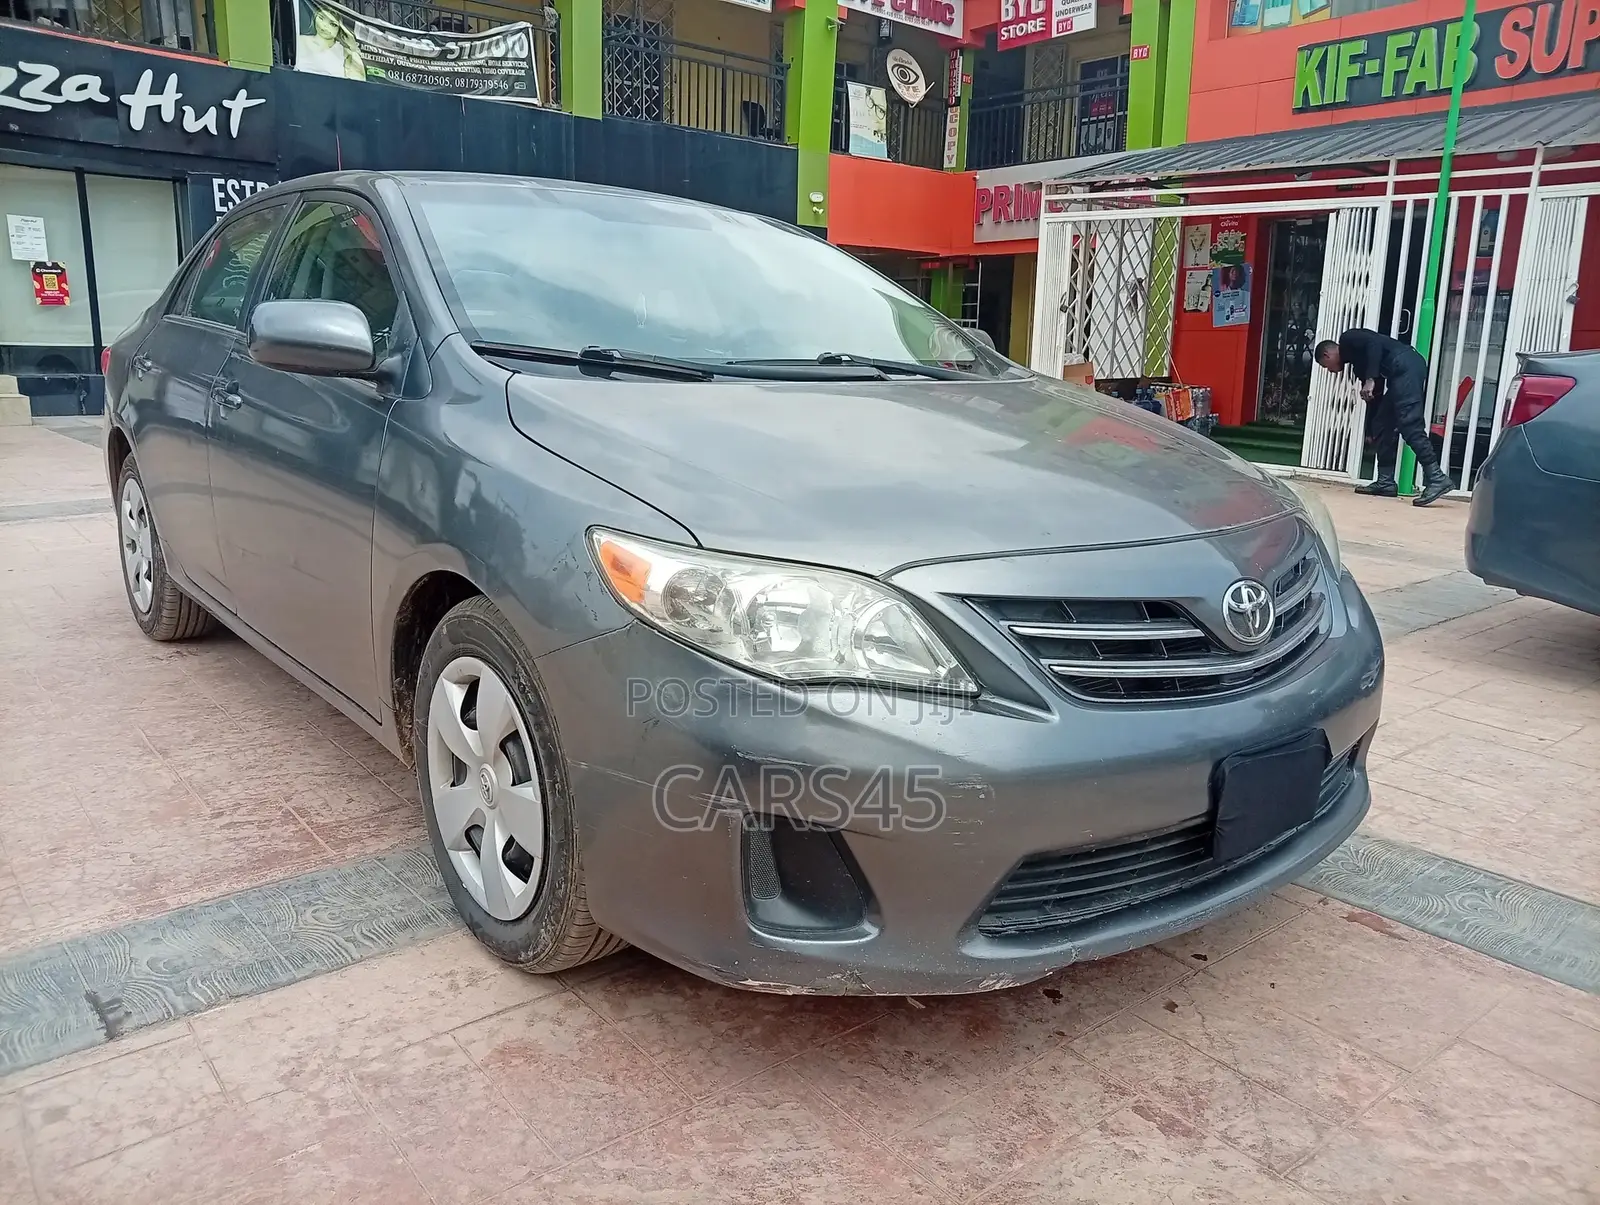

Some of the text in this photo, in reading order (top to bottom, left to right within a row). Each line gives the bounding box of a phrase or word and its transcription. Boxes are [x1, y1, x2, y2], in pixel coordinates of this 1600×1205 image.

[1001, 17, 1046, 40] STORE
[1055, 3, 1092, 18] UNDERWEAR
[1292, 21, 1480, 109] KIF-FAB
[119, 69, 266, 138] Hut
